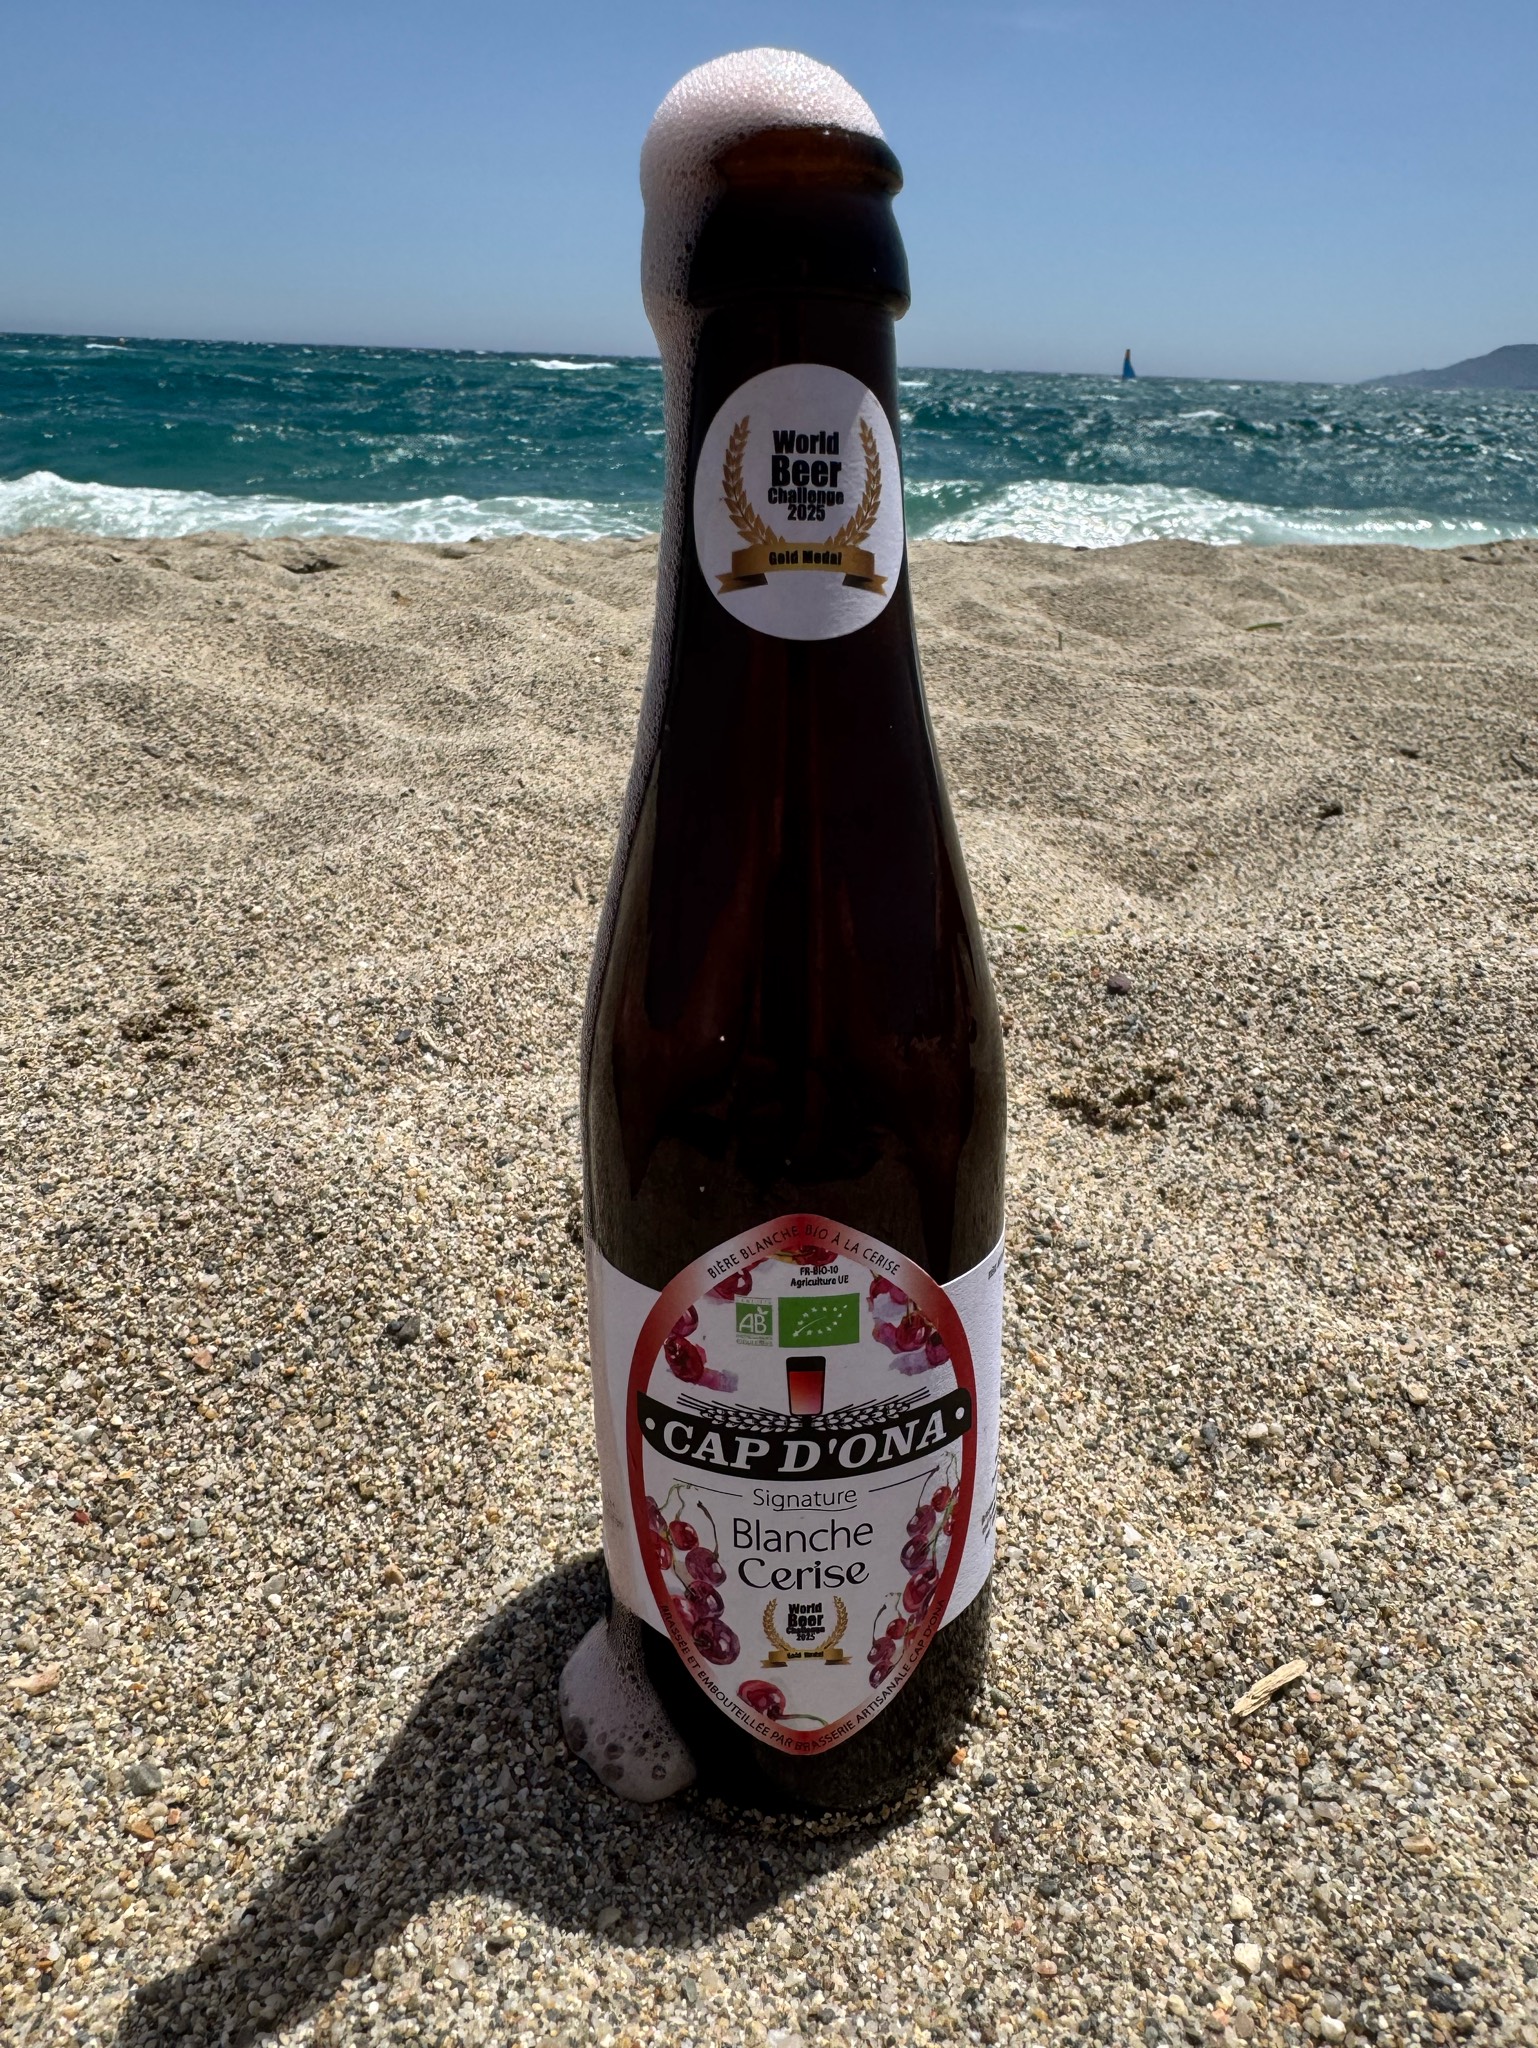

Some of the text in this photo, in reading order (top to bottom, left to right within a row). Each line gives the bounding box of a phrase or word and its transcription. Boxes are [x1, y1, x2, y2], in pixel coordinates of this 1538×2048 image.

[773, 430, 839, 455] World
[771, 455, 842, 487] Beer
[767, 487, 844, 505] Challenge
[787, 504, 825, 521] 2025
[768, 550, 842, 565] Gold Medal
[707, 1254, 740, 1279] BIÈRE
[740, 1226, 799, 1259] BLANCHE
[805, 1224, 828, 1239] BIO
[844, 1239, 860, 1254] LA
[862, 1248, 900, 1275] CERISE
[800, 1265, 839, 1276] FR-BIO-10
[790, 1275, 849, 1288] Agriculture UE
[739, 1313, 767, 1334] AB
[663, 1409, 947, 1473] CAP D'ONA
[753, 1488, 858, 1512] Signature
[733, 1517, 873, 1552] Blanche
[738, 1557, 869, 1590] Cerise
[788, 1603, 822, 1614] World
[787, 1614, 824, 1627] Beer
[796, 1633, 815, 1641] 2025
[687, 1656, 700, 1669] ET
[697, 1670, 770, 1736] EMBOUTEILLÉE
[770, 1731, 793, 1748] PAR
[795, 1720, 855, 1752] BRASSERIE
[856, 1664, 911, 1724] ARTISANALE
[910, 1640, 925, 1662] CAP
